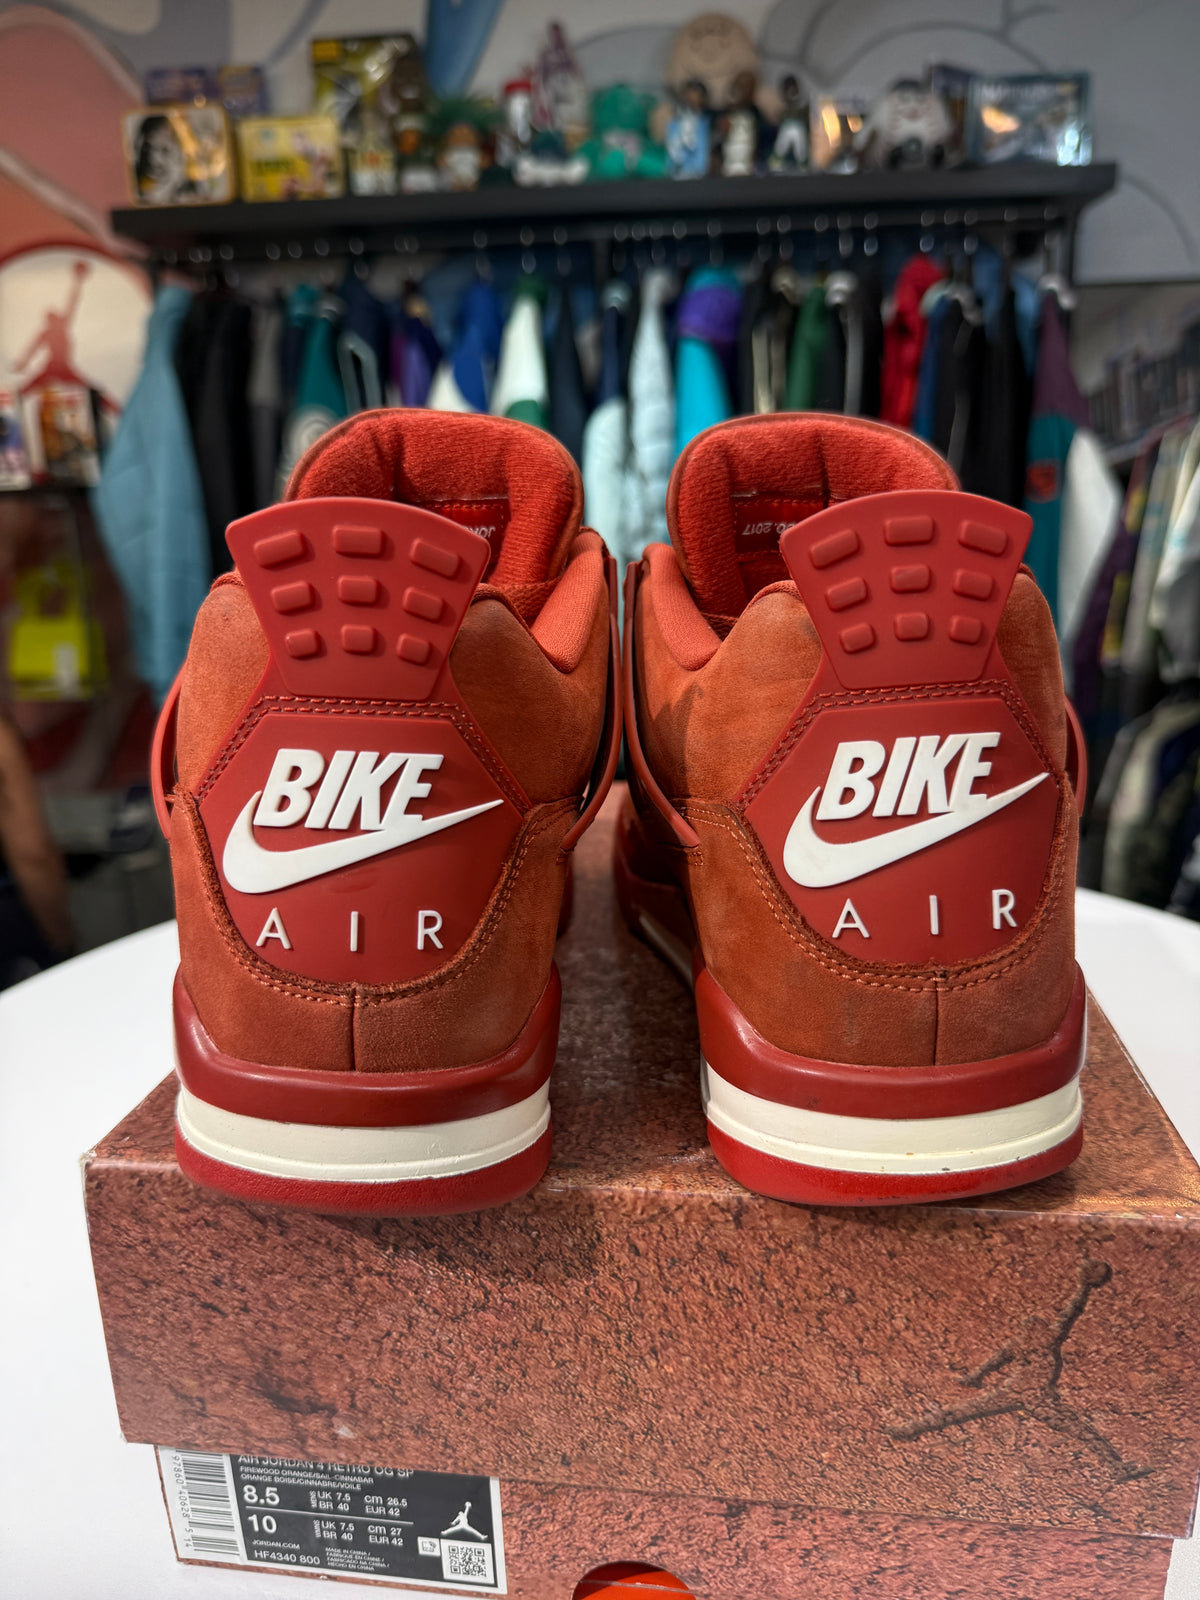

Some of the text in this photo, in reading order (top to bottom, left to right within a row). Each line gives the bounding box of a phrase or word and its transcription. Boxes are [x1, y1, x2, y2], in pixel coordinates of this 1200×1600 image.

[742, 522, 773, 535] 2017
[815, 731, 1002, 822] BIKE
[253, 748, 445, 831] BIKE
[832, 888, 1018, 938] AIR
[256, 907, 444, 952] AIR
[262, 1456, 314, 1470] JORDAN
[239, 1466, 280, 1475] FIREWOOD
[241, 1473, 273, 1482] ORANGE
[243, 1484, 280, 1505] 8.5
[317, 1490, 351, 1502] UK 7.5
[364, 1494, 408, 1507] cm 26.5
[318, 1501, 350, 1511] BR 40
[365, 1505, 400, 1517] EUR 42
[247, 1514, 277, 1534] 10
[321, 1520, 355, 1532] UK 7.5
[322, 1530, 353, 1542] BR 40
[368, 1525, 402, 1536] cm 27
[252, 1539, 301, 1550] JORDAN.COM
[368, 1535, 404, 1546] EUR 42
[254, 1550, 320, 1565] HF4340 800
